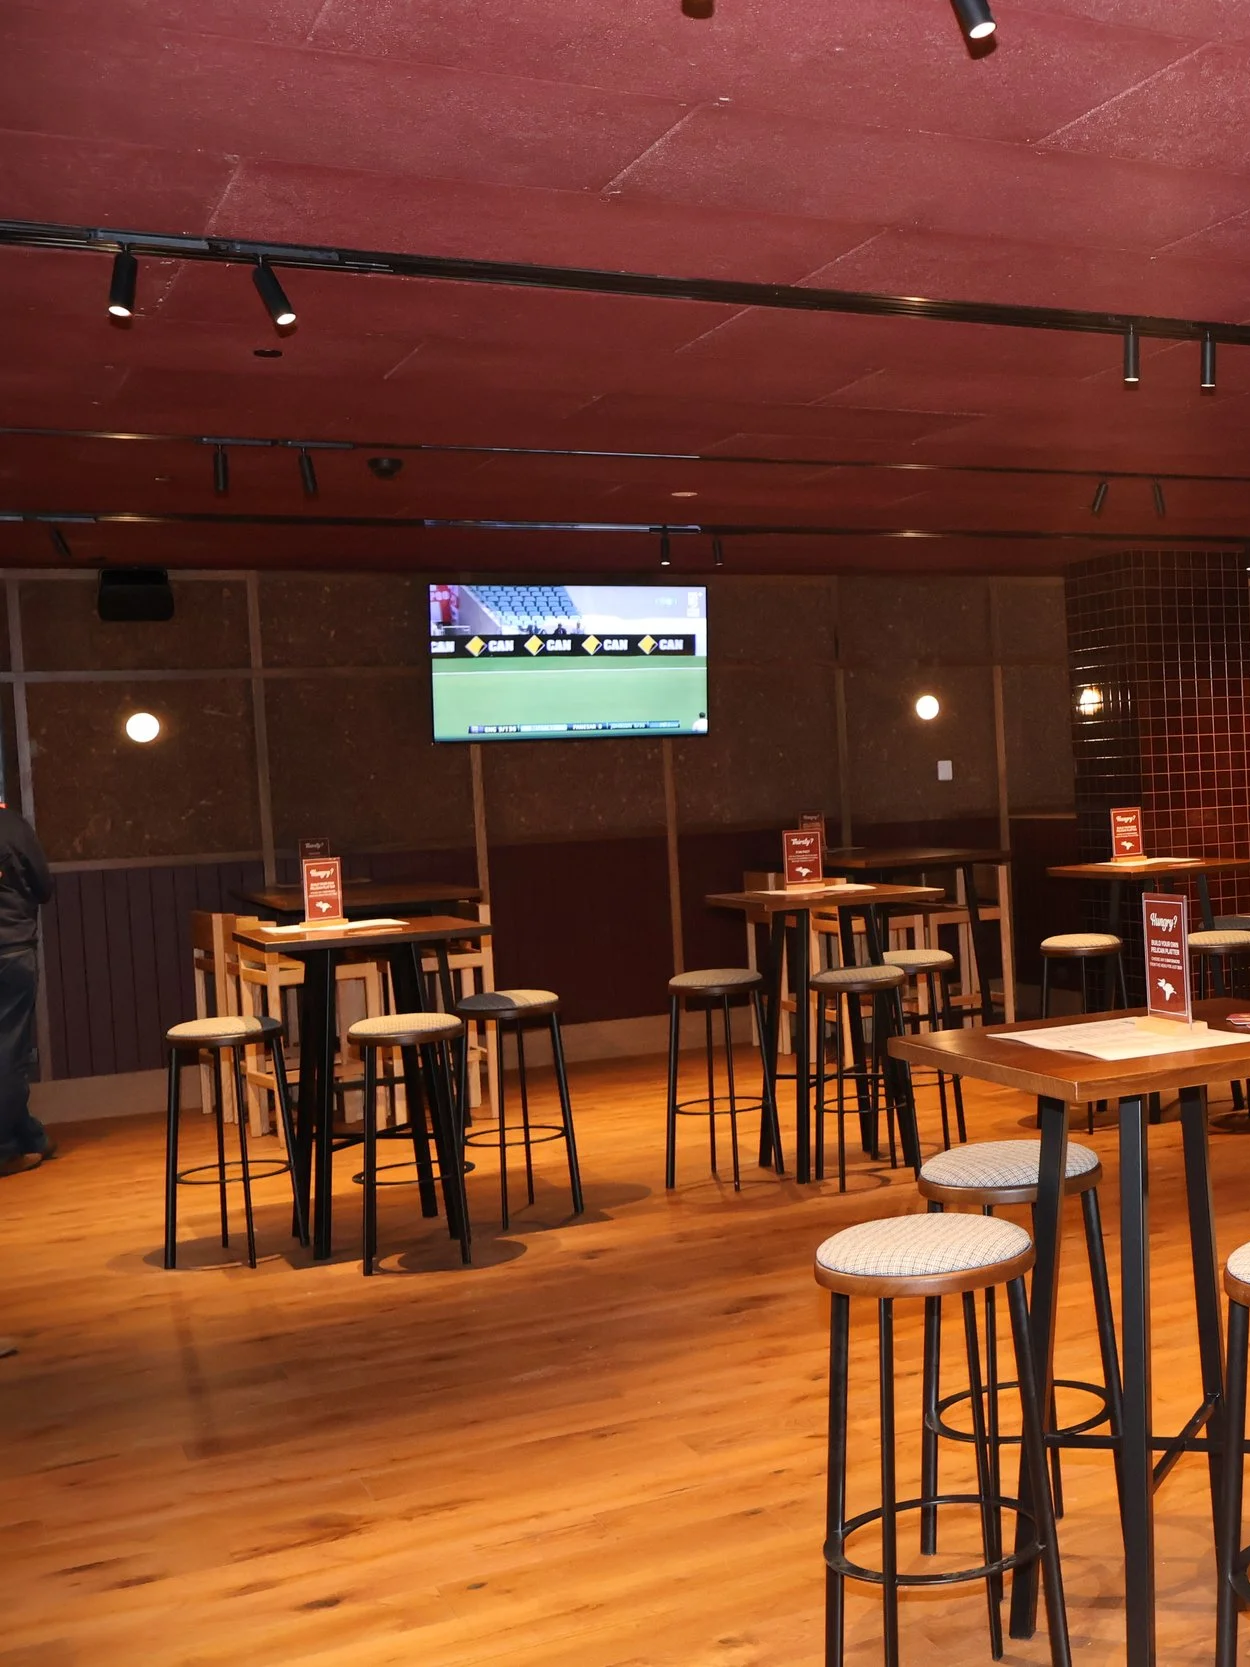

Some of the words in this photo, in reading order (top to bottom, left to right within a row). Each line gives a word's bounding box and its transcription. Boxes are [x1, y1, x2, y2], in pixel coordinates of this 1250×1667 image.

[488, 640, 514, 652] CAN
[546, 639, 572, 651] CAN
[603, 639, 628, 651] CAN
[658, 639, 684, 651] CAN
[1150, 912, 1178, 932] Hungry?
